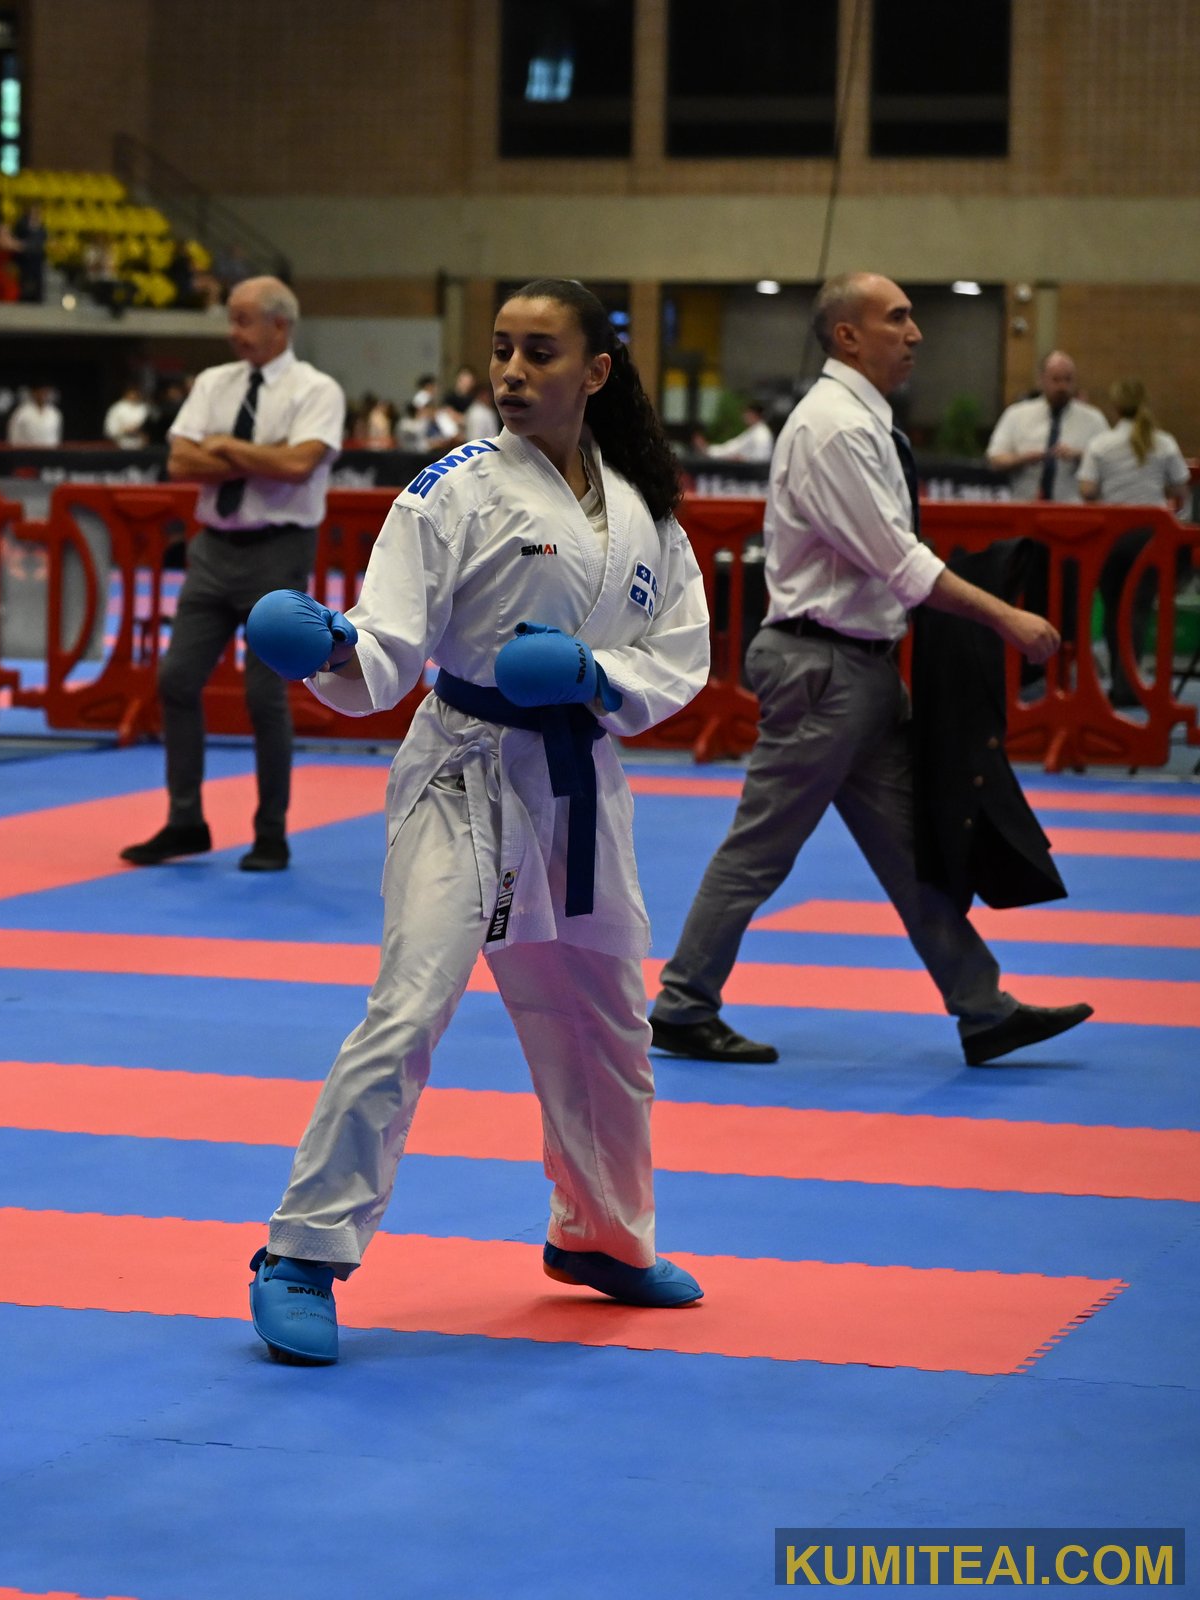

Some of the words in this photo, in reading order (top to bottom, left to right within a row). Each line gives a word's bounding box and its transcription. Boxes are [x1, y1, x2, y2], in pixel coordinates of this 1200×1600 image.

[408, 440, 500, 499] SMAI
[521, 544, 557, 556] SMAI
[492, 912, 506, 936] JIN
[287, 1286, 330, 1301] SMAI
